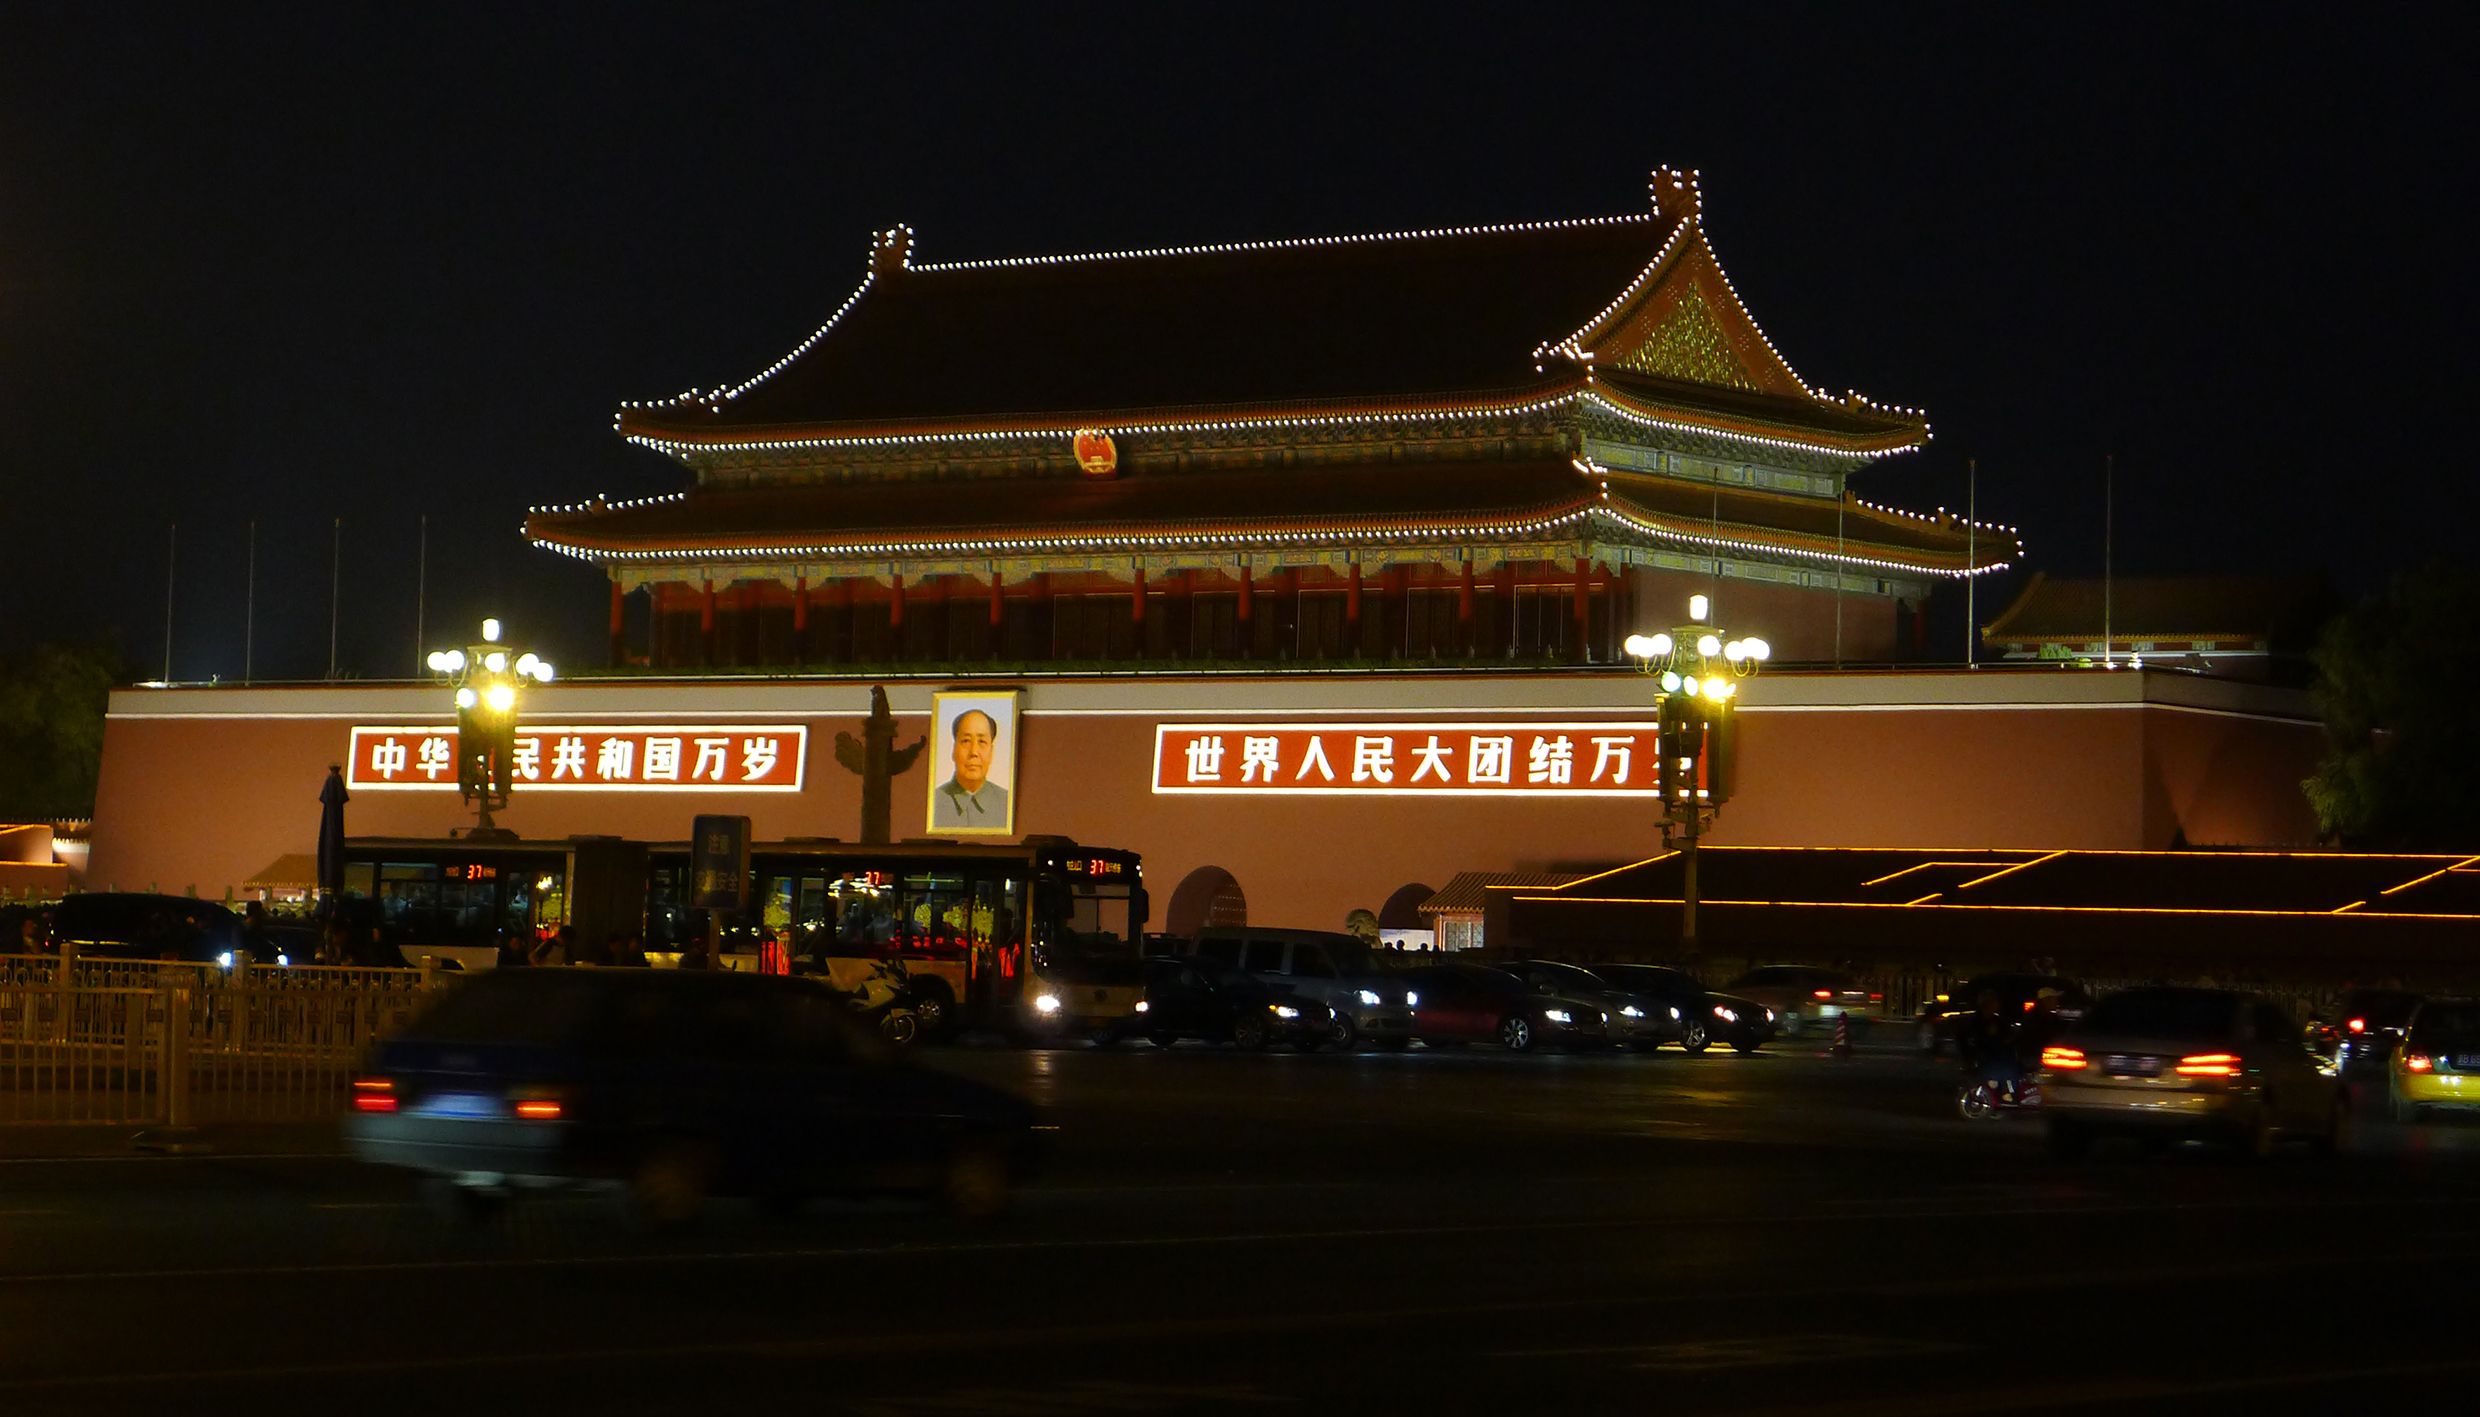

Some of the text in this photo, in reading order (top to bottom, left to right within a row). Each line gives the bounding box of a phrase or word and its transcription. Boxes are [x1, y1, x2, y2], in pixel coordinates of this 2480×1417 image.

[371, 737, 779, 781] 中华民共和国万岁
[1184, 735, 1692, 785] 世界人民大团结万
[467, 864, 483, 880] 37
[1089, 859, 1105, 875] 37
